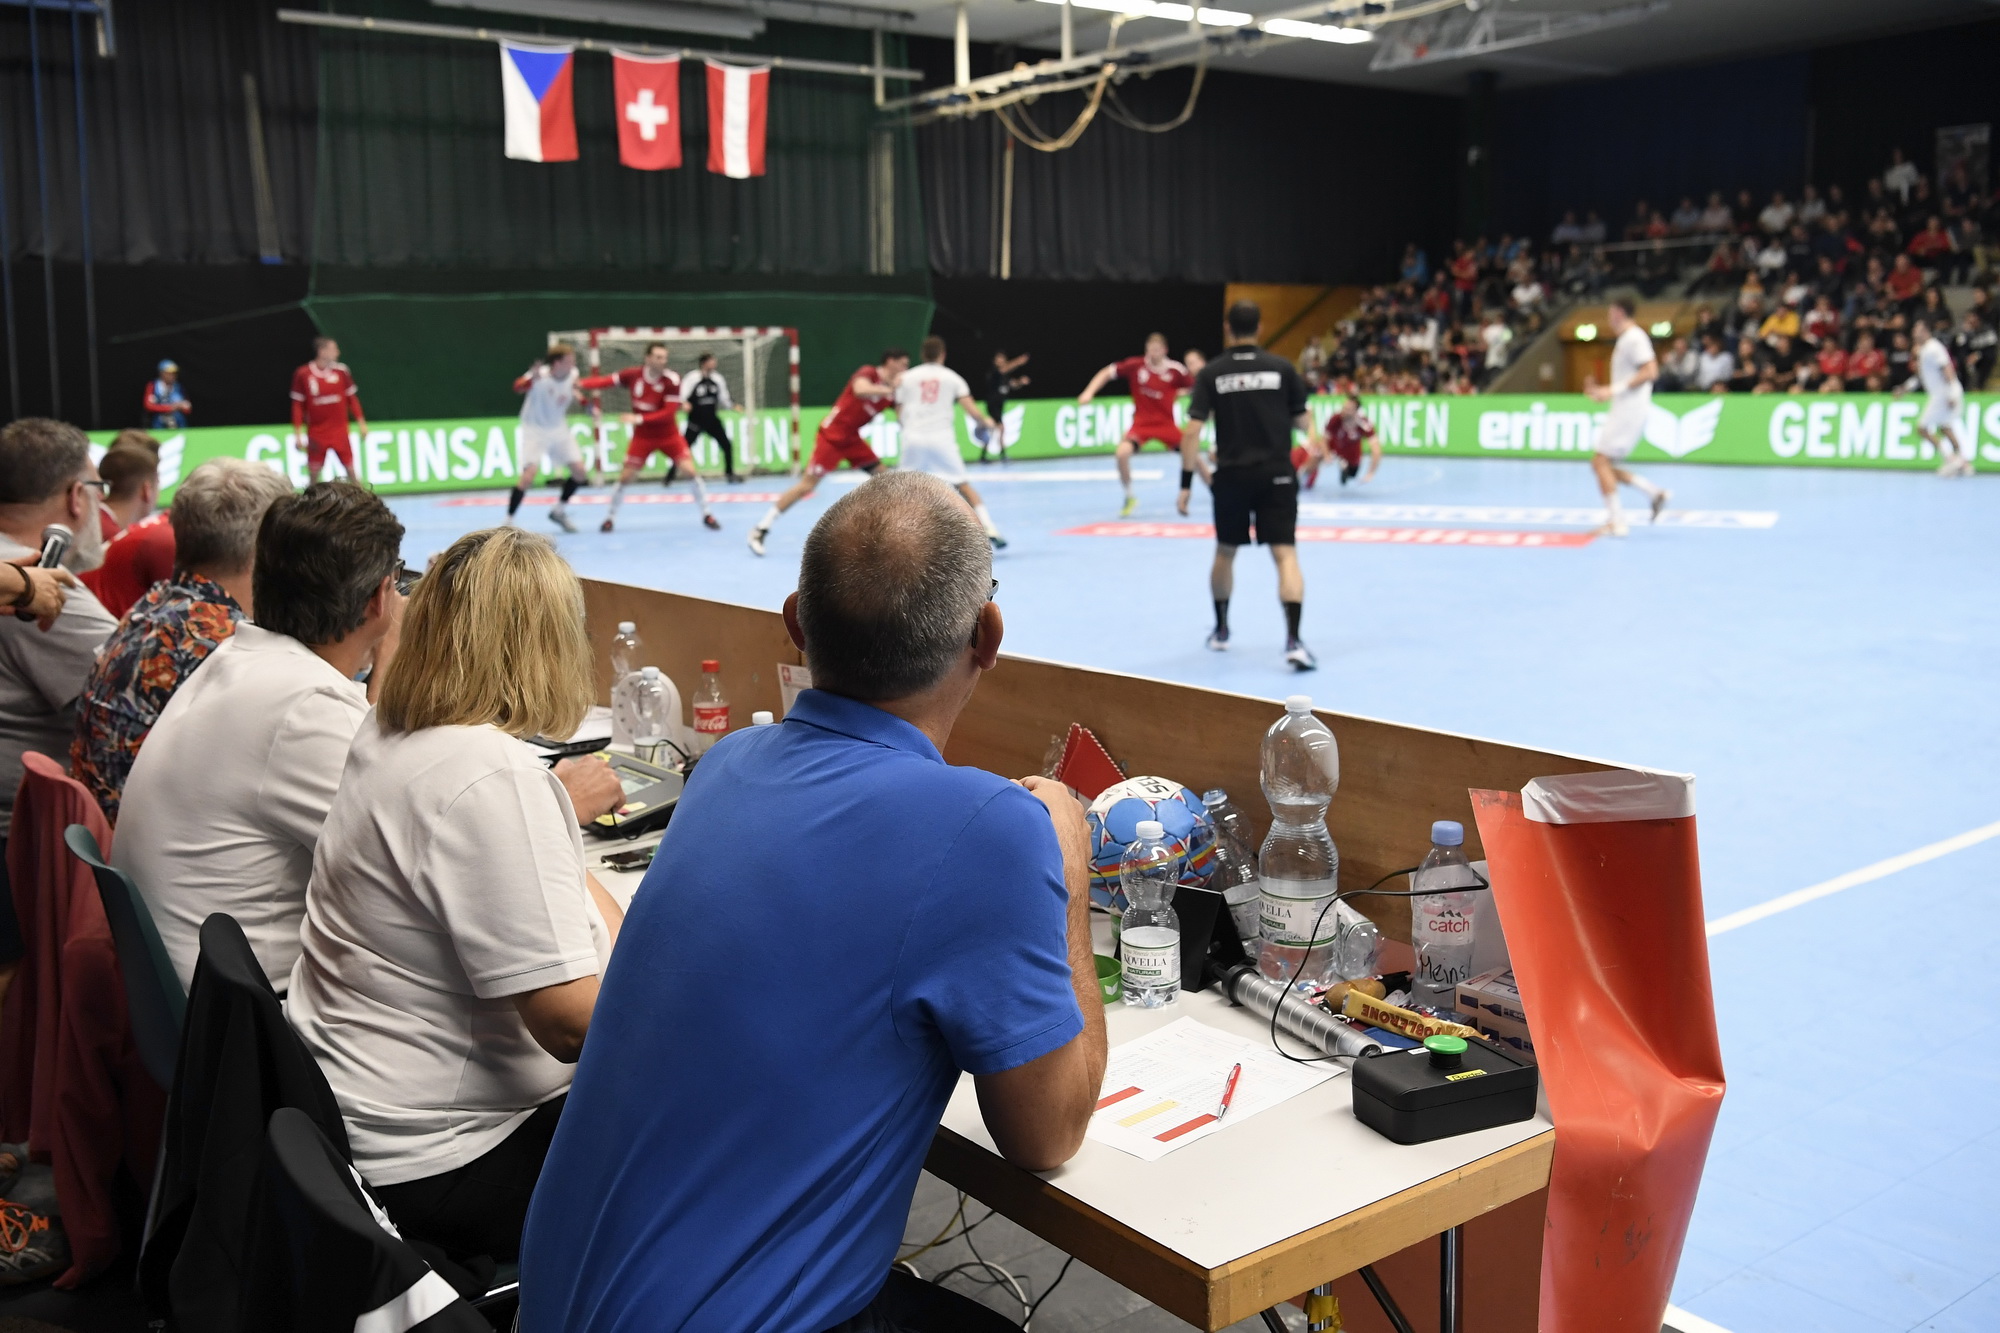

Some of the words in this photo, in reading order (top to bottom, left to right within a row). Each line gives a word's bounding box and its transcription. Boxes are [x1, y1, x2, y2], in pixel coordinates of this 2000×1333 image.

[1428, 917, 1470, 933] catch
[1124, 953, 1167, 967] NOVELLA
[1128, 968, 1161, 976] NATURALE
